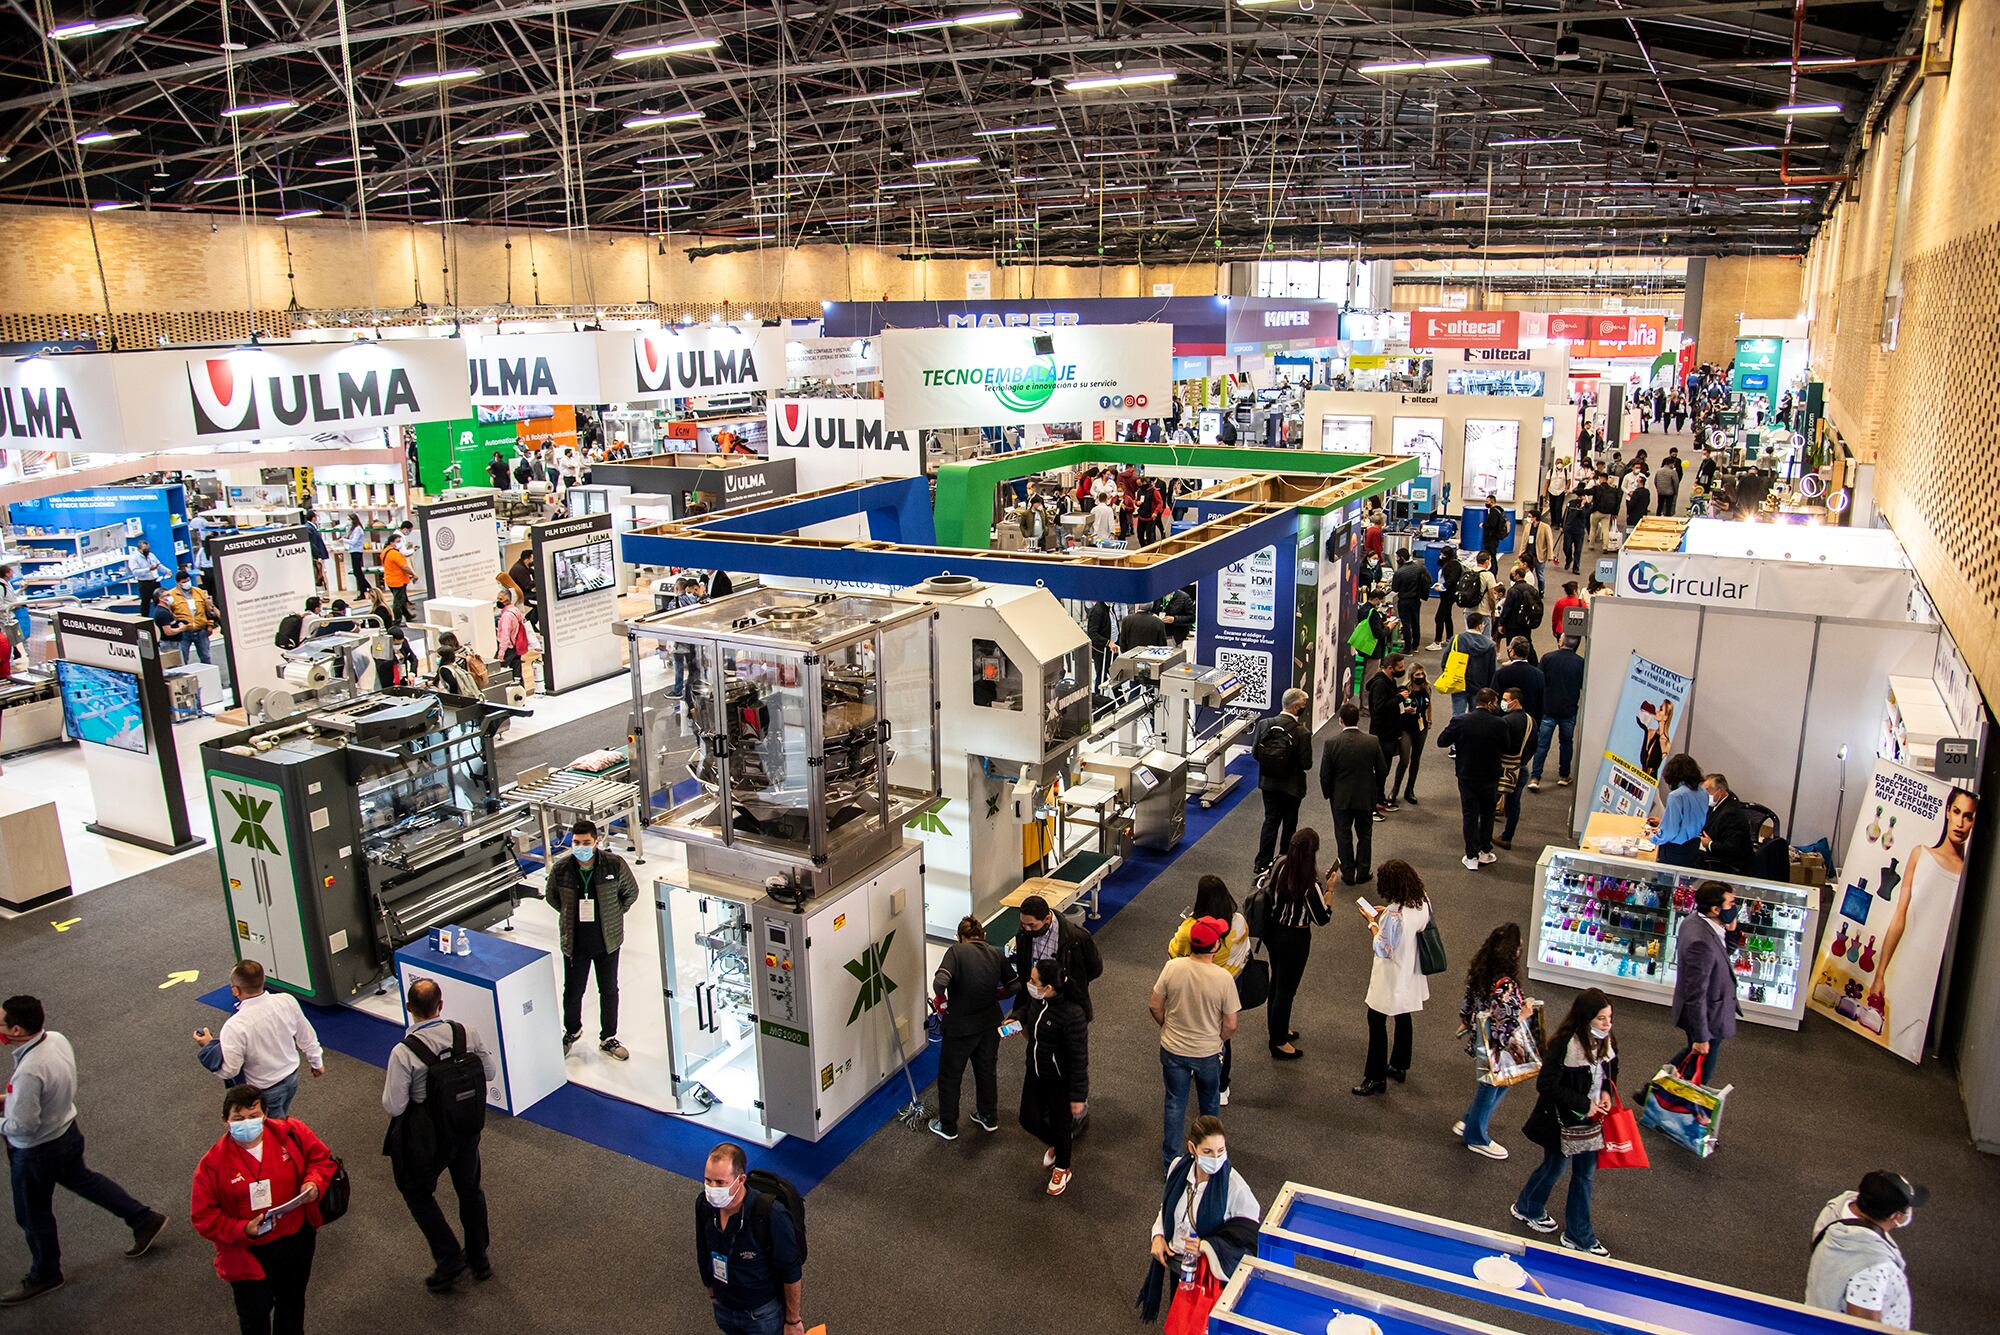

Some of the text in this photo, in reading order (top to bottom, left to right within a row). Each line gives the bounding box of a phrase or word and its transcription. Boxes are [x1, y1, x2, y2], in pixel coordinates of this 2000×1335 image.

[1428, 318, 1502, 337] Soltecal
[676, 348, 759, 389] ULMA
[922, 364, 1077, 386] TECNOEMBALAJE
[984, 384, 1024, 394] Tecnología
[1032, 382, 1072, 390] innovación
[268, 368, 421, 426] ULMA
[814, 417, 910, 452] ULMA
[738, 473, 766, 490] ULMA
[476, 512, 492, 521] ULMA
[545, 521, 593, 537] FILM EXTENSIBLE
[224, 532, 297, 551] ASISTENCIA TÉCNICA
[594, 533, 610, 543] ULMA
[285, 546, 306, 557] ULMA
[1227, 563, 1244, 573] OK
[1251, 576, 1272, 585] HDM
[62, 619, 123, 636] GLOBAL PACKAGING
[1567, 618, 1583, 626] 202
[116, 647, 137, 659] ULMA
[1945, 753, 1968, 764] 201
[1875, 774, 1943, 807] ESPECTACULARES
[1893, 773, 1928, 792] FRASCOS
[1875, 782, 1939, 814] PARA PERFUMES
[1875, 790, 1936, 820] MUY EXITOSOS!
